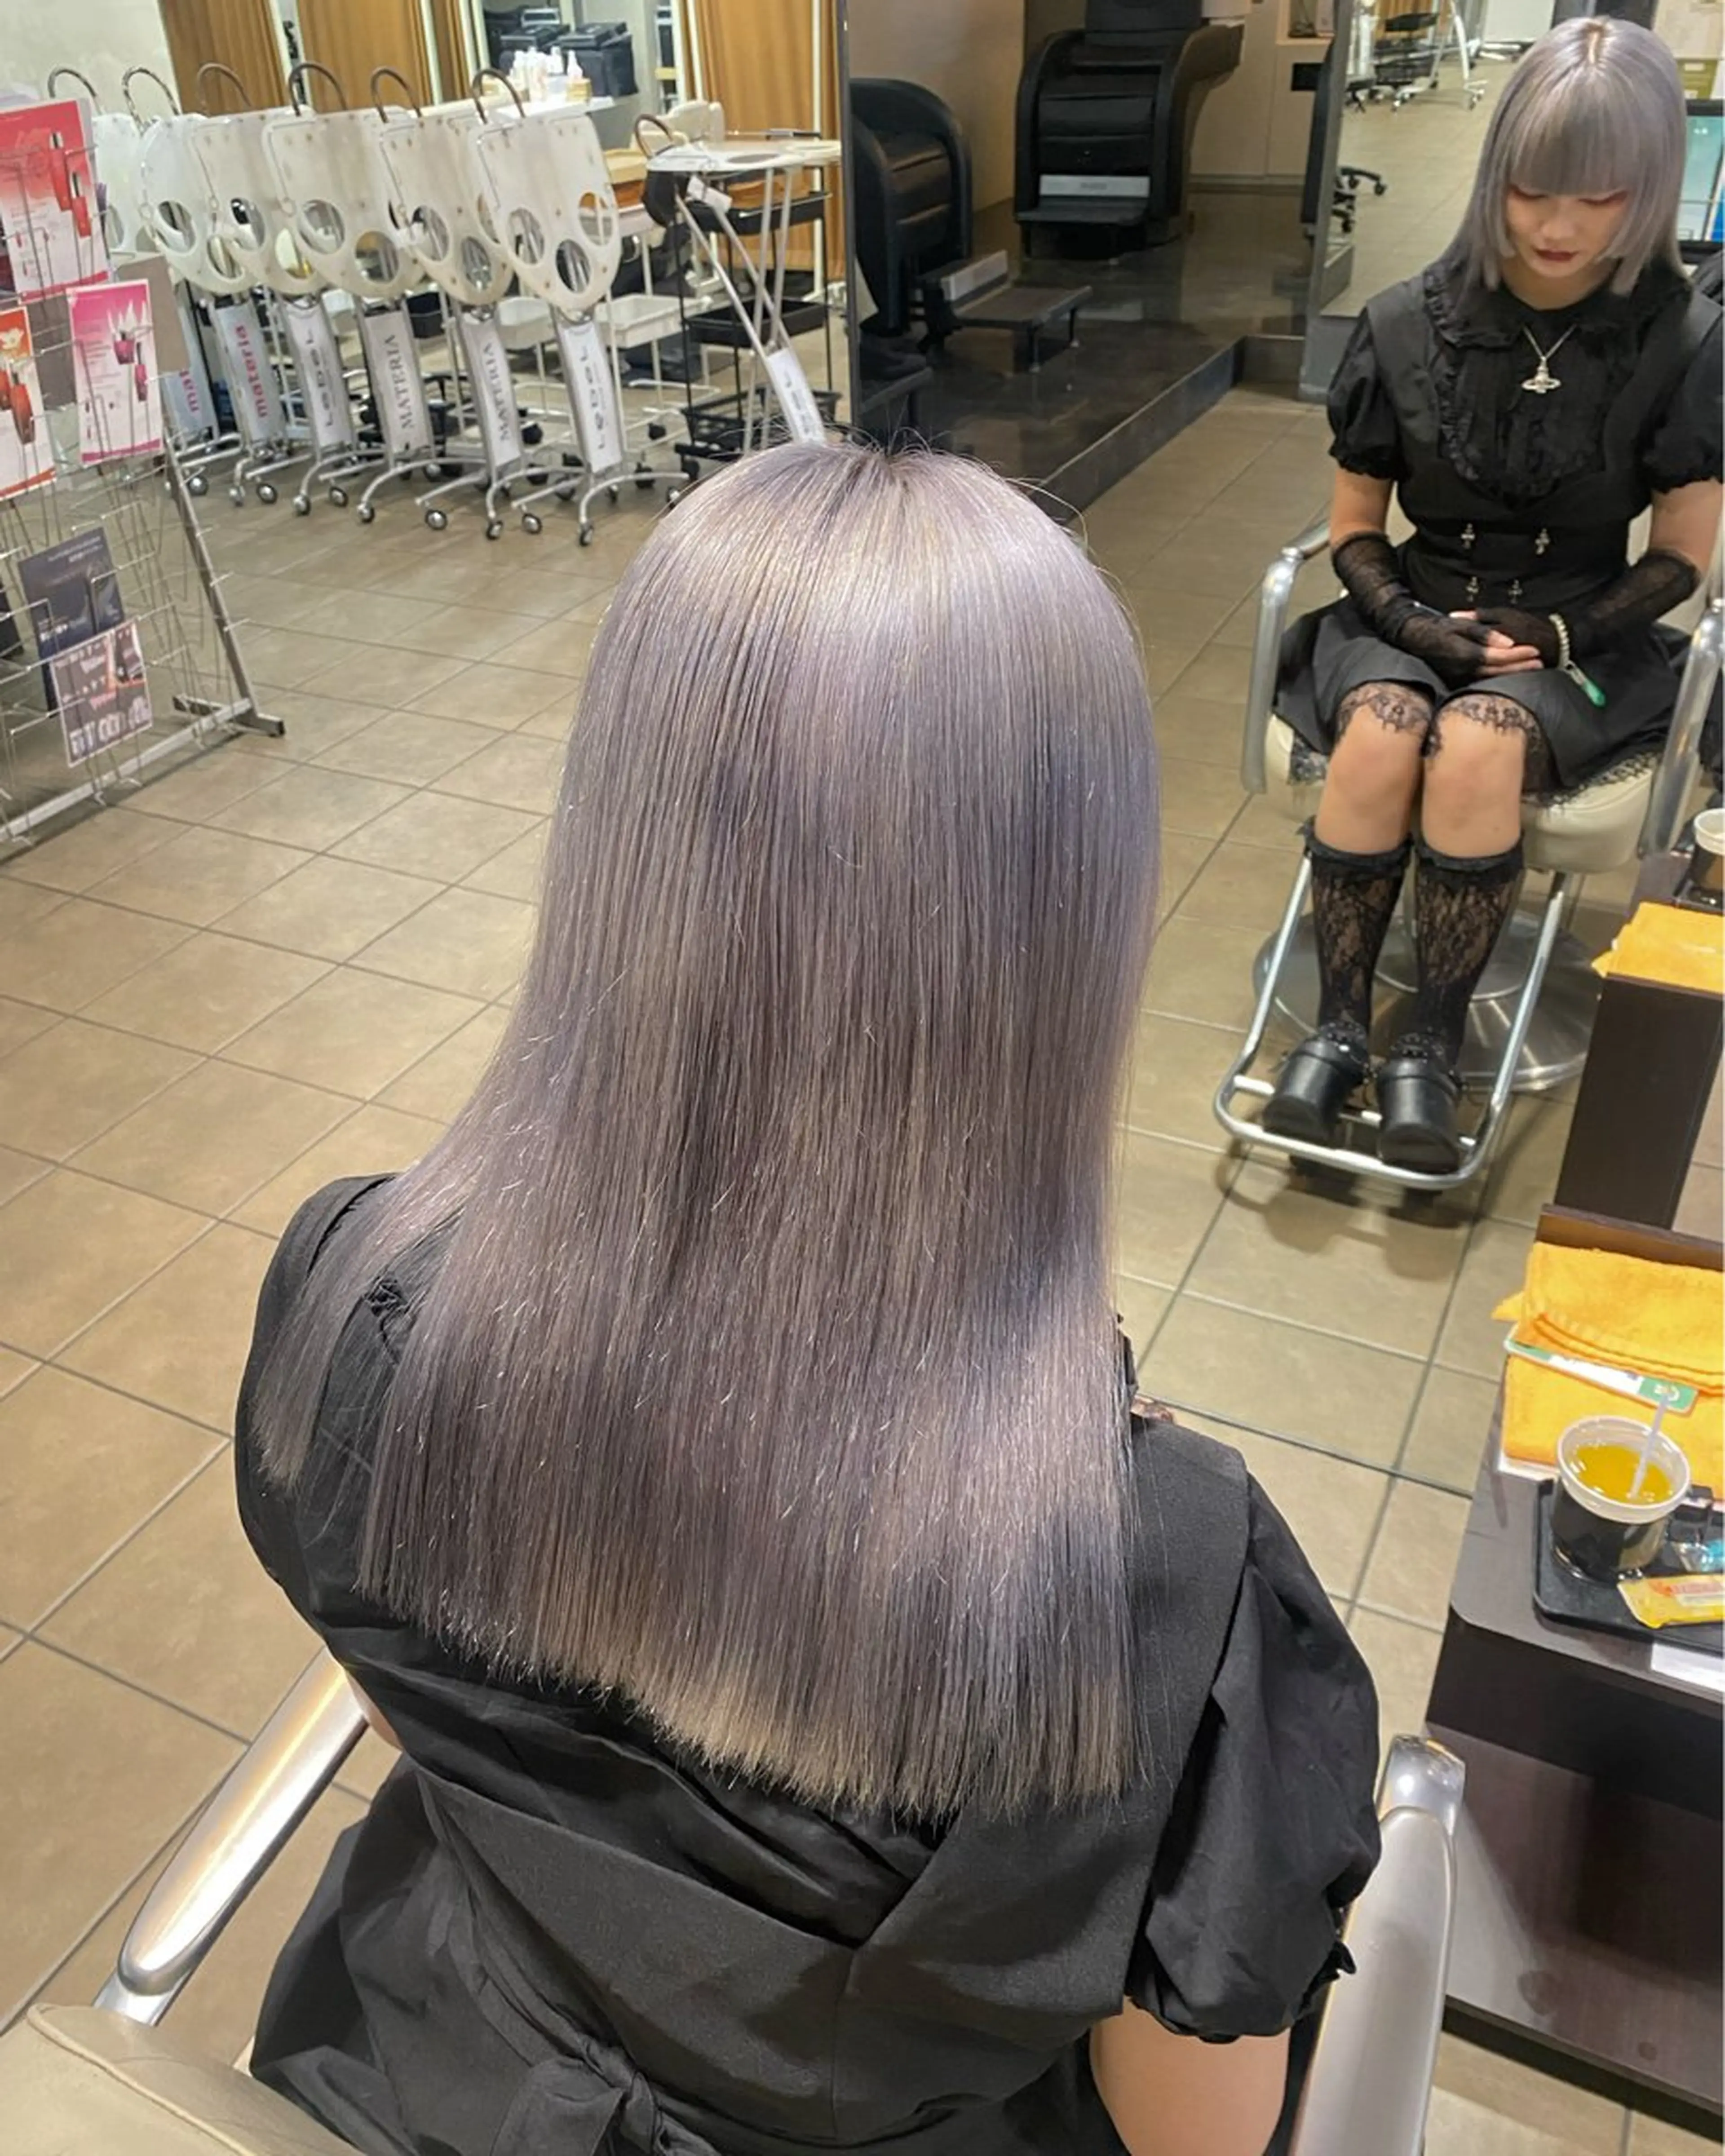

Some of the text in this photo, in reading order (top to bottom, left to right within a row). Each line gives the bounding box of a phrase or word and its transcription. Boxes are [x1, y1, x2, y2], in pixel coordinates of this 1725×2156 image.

[235, 324, 268, 418] materia
[385, 334, 414, 429] MATERIA
[484, 342, 509, 442] MATERIA
